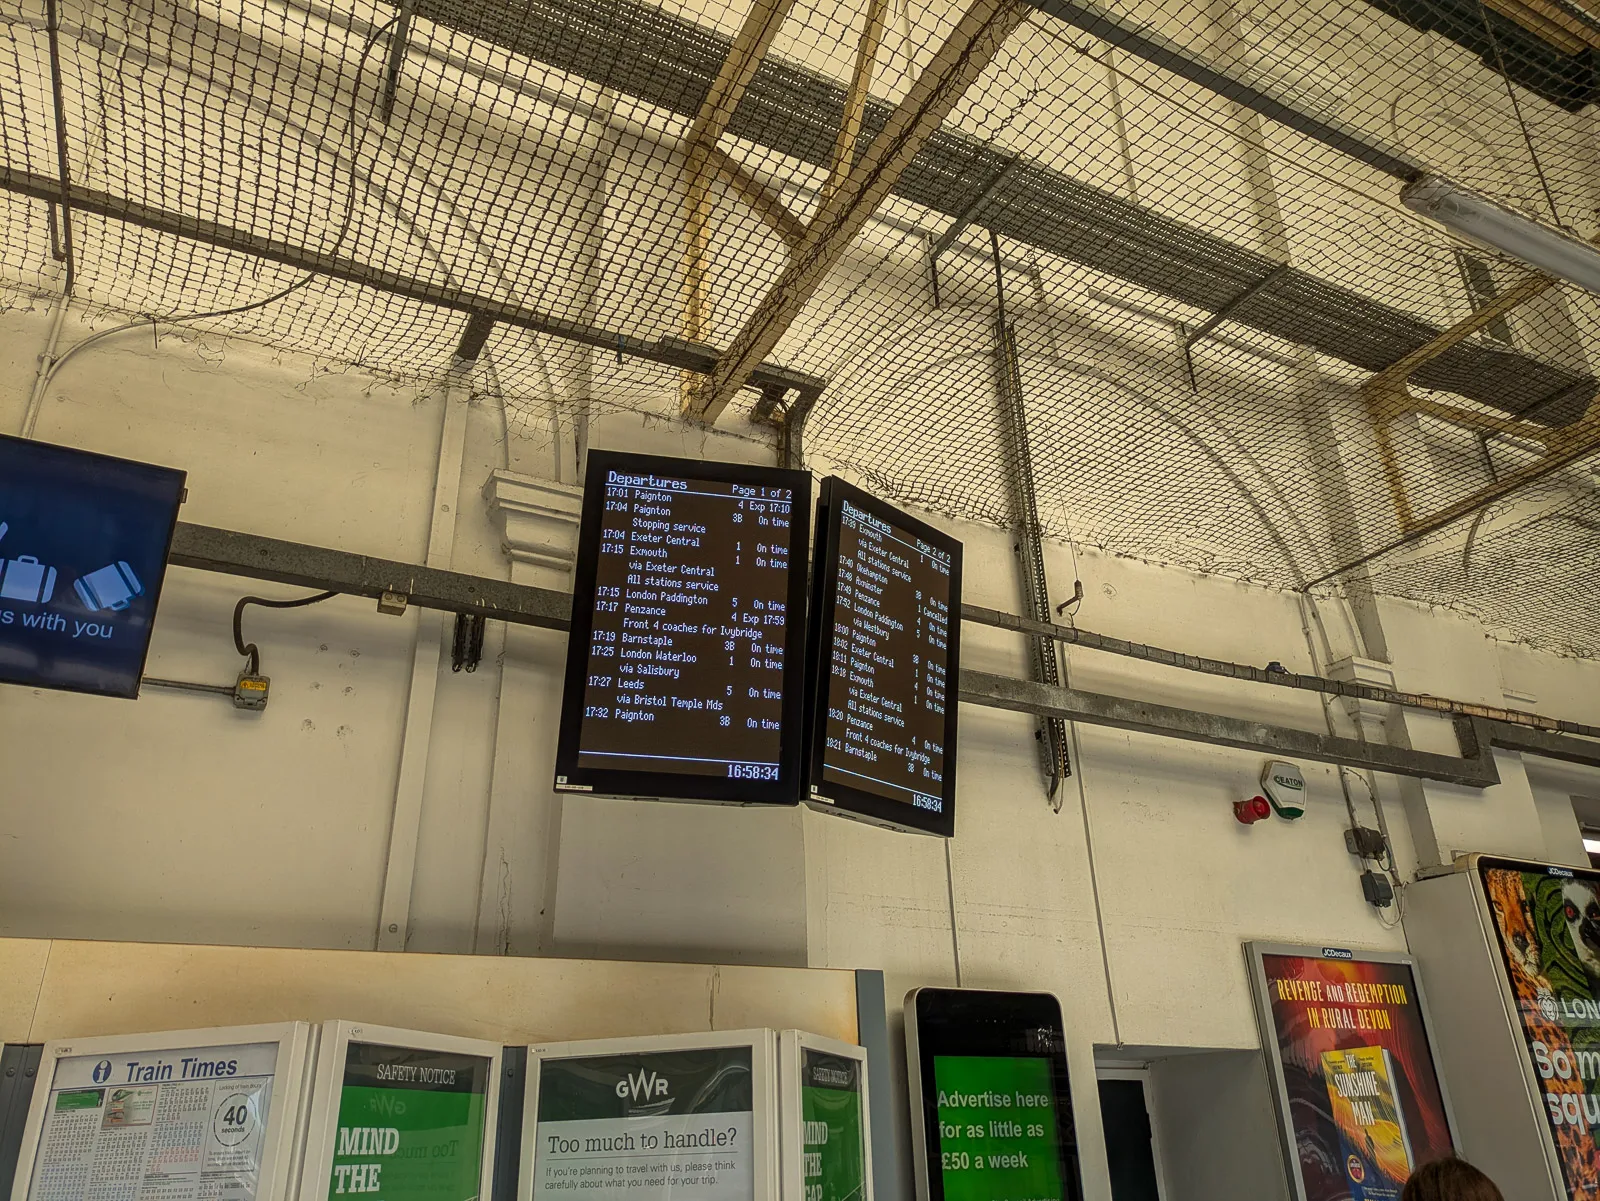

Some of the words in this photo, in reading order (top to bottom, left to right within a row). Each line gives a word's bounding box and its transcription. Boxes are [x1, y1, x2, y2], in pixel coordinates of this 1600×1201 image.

[607, 470, 688, 490] Departures
[731, 483, 756, 497] Page
[760, 486, 765, 497] 1
[769, 488, 782, 498] of
[785, 489, 792, 499] 2
[606, 486, 628, 498] 17:01
[634, 488, 672, 503] Paignton
[749, 500, 766, 513] Exp
[769, 502, 790, 514] 17:10
[605, 500, 628, 512] 17:04
[633, 503, 671, 517] Paignton
[732, 512, 743, 523] 3B
[757, 515, 769, 525] On
[771, 516, 790, 528] time
[632, 516, 670, 532] Stopping
[672, 522, 706, 534] service
[841, 499, 893, 535] Departures
[602, 528, 626, 540] 17:04
[630, 531, 663, 543] Exeter
[665, 534, 700, 547] Central
[756, 542, 767, 553] On
[770, 543, 788, 555] time
[916, 538, 931, 553] Page
[932, 546, 937, 556] 2
[937, 551, 945, 560] of
[946, 553, 951, 563] 2
[601, 542, 624, 554] 17:15
[629, 545, 668, 558] Exmouth
[755, 556, 767, 567] On
[769, 557, 788, 569] time
[868, 541, 888, 557] Exeter
[888, 551, 909, 569] Central
[628, 559, 643, 570] via
[645, 560, 678, 573] Exeter
[680, 563, 715, 577] Central
[626, 573, 641, 585] All
[644, 575, 682, 588] stations
[685, 580, 719, 591] service
[597, 585, 620, 598] 17:15
[625, 588, 657, 601] London
[659, 590, 708, 606] Paddington
[753, 598, 764, 610] On
[767, 600, 786, 612] time
[22, 612, 67, 632] with
[72, 620, 113, 639] you
[595, 600, 619, 612] 17:17
[624, 602, 666, 616] Penzance
[742, 612, 760, 626] Exp
[763, 614, 785, 626] 17:59
[853, 602, 874, 619] London
[874, 610, 904, 631] Paddington
[923, 606, 948, 625] Cancelled
[623, 617, 649, 630] Front
[652, 620, 659, 630] 4
[661, 621, 698, 633] coaches
[701, 623, 717, 635] for
[719, 625, 763, 640] Ivybridge
[592, 629, 616, 642] 17:19
[621, 631, 673, 648] Barnstaple
[724, 640, 735, 651] 3B
[750, 642, 762, 653] On
[764, 643, 784, 655] time
[591, 645, 615, 657] 17:25
[620, 647, 652, 660] London
[654, 649, 697, 663] Waterloo
[749, 657, 761, 668] On
[764, 658, 783, 670] time
[619, 662, 634, 674] via
[636, 663, 680, 679] Salisbury
[588, 675, 612, 687] 17:27
[617, 677, 645, 690] Leeds
[748, 686, 760, 698] On
[762, 687, 781, 700] time
[616, 693, 631, 704] via
[633, 693, 667, 707] Bristol
[670, 696, 703, 711] Temple
[705, 698, 723, 711] Mds
[585, 706, 609, 718] 17:32
[614, 708, 655, 722] Paignton
[719, 715, 731, 727] 3B
[746, 716, 758, 728] On
[760, 718, 780, 730] time
[727, 763, 779, 781] 16:58:34
[912, 793, 942, 813] 16:58:34
[1323, 949, 1352, 958] JCDecaux
[1277, 979, 1324, 1002] REVENGE
[1326, 985, 1345, 1003] AND
[1345, 982, 1408, 1005] REDEMPTION
[1307, 1007, 1320, 1028] IN
[1322, 1008, 1356, 1029] RURAL
[1357, 1009, 1391, 1030] DEVON
[126, 1060, 172, 1082] Train
[181, 1058, 238, 1078] Times
[1345, 1054, 1357, 1068] THE
[1533, 1040, 1572, 1080] So
[376, 1063, 417, 1082] SAFETY
[419, 1067, 456, 1085] NOTICE
[615, 1067, 669, 1102] GWR
[1334, 1071, 1380, 1098] SUNSHINE
[937, 1090, 1011, 1108] Advertise
[1016, 1091, 1049, 1107] here
[223, 1105, 248, 1125] 40
[1351, 1101, 1375, 1126] MAN
[337, 1127, 400, 1156] MIND
[548, 1136, 580, 1154] Too
[585, 1132, 635, 1152] much
[640, 1133, 658, 1149] to
[663, 1127, 737, 1149] handle?
[803, 1120, 828, 1145] MIND
[939, 1121, 962, 1139] for
[966, 1124, 985, 1138] as
[989, 1120, 1022, 1138] little
[1027, 1123, 1044, 1137] as
[546, 1167, 552, 1176] If
[579, 1164, 613, 1176] planning
[615, 1165, 624, 1174] to
[626, 1163, 648, 1174] travel
[650, 1162, 668, 1173] with
[670, 1163, 683, 1173] us,
[685, 1161, 712, 1174] please
[714, 1160, 736, 1170] think
[804, 1152, 822, 1177] THE
[941, 1151, 969, 1170] £50
[974, 1155, 984, 1169] a
[988, 1151, 1029, 1168] week
[334, 1164, 382, 1194] THE
[544, 1179, 579, 1191] carefully
[579, 1178, 603, 1189] about
[605, 1178, 626, 1188] what
[627, 1179, 643, 1189] you
[644, 1176, 665, 1186] need
[667, 1176, 678, 1186] for
[680, 1177, 700, 1187] your
[701, 1175, 718, 1187] trip.
